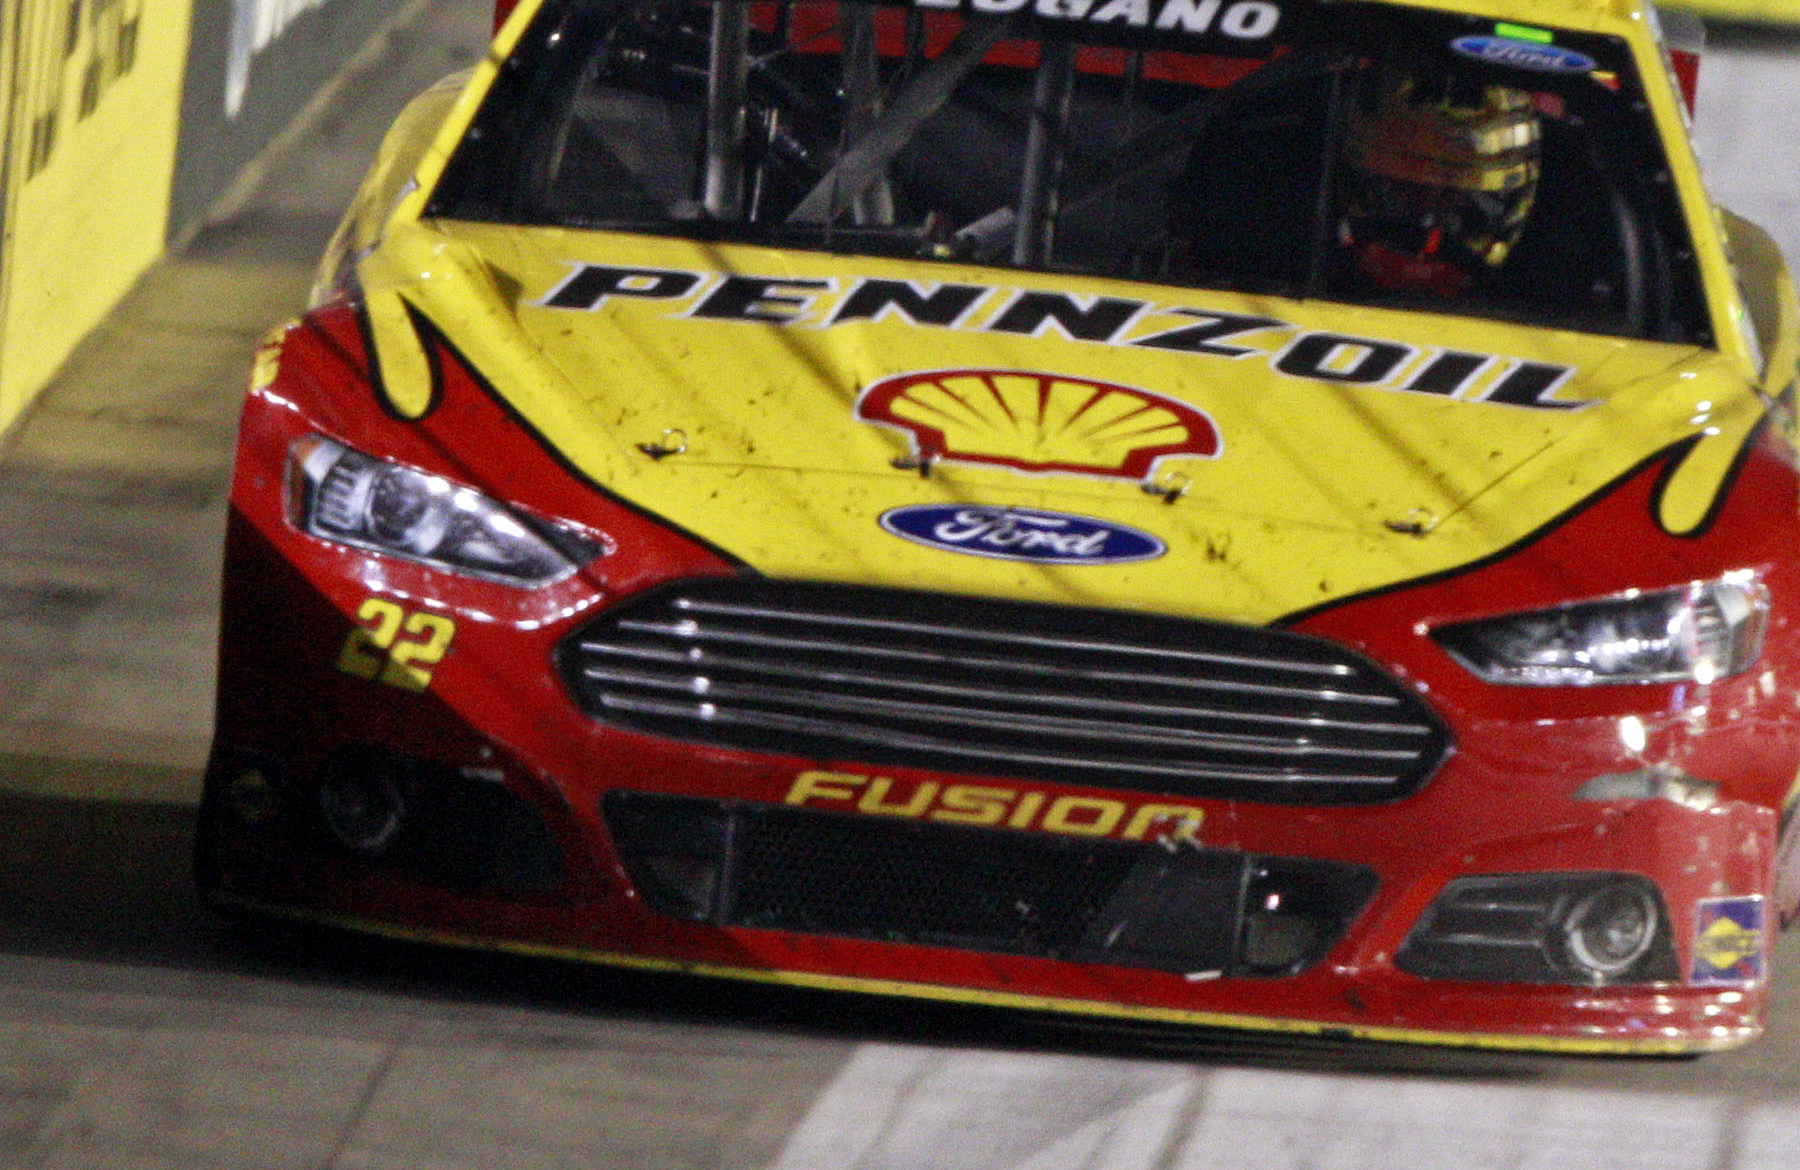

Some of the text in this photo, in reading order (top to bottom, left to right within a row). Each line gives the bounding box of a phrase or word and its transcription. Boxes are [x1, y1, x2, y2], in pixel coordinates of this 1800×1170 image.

[536, 262, 1605, 412] PENNZOIL
[934, 510, 1108, 555] Ford
[337, 597, 456, 691] 22
[784, 770, 1206, 840] FUSION
